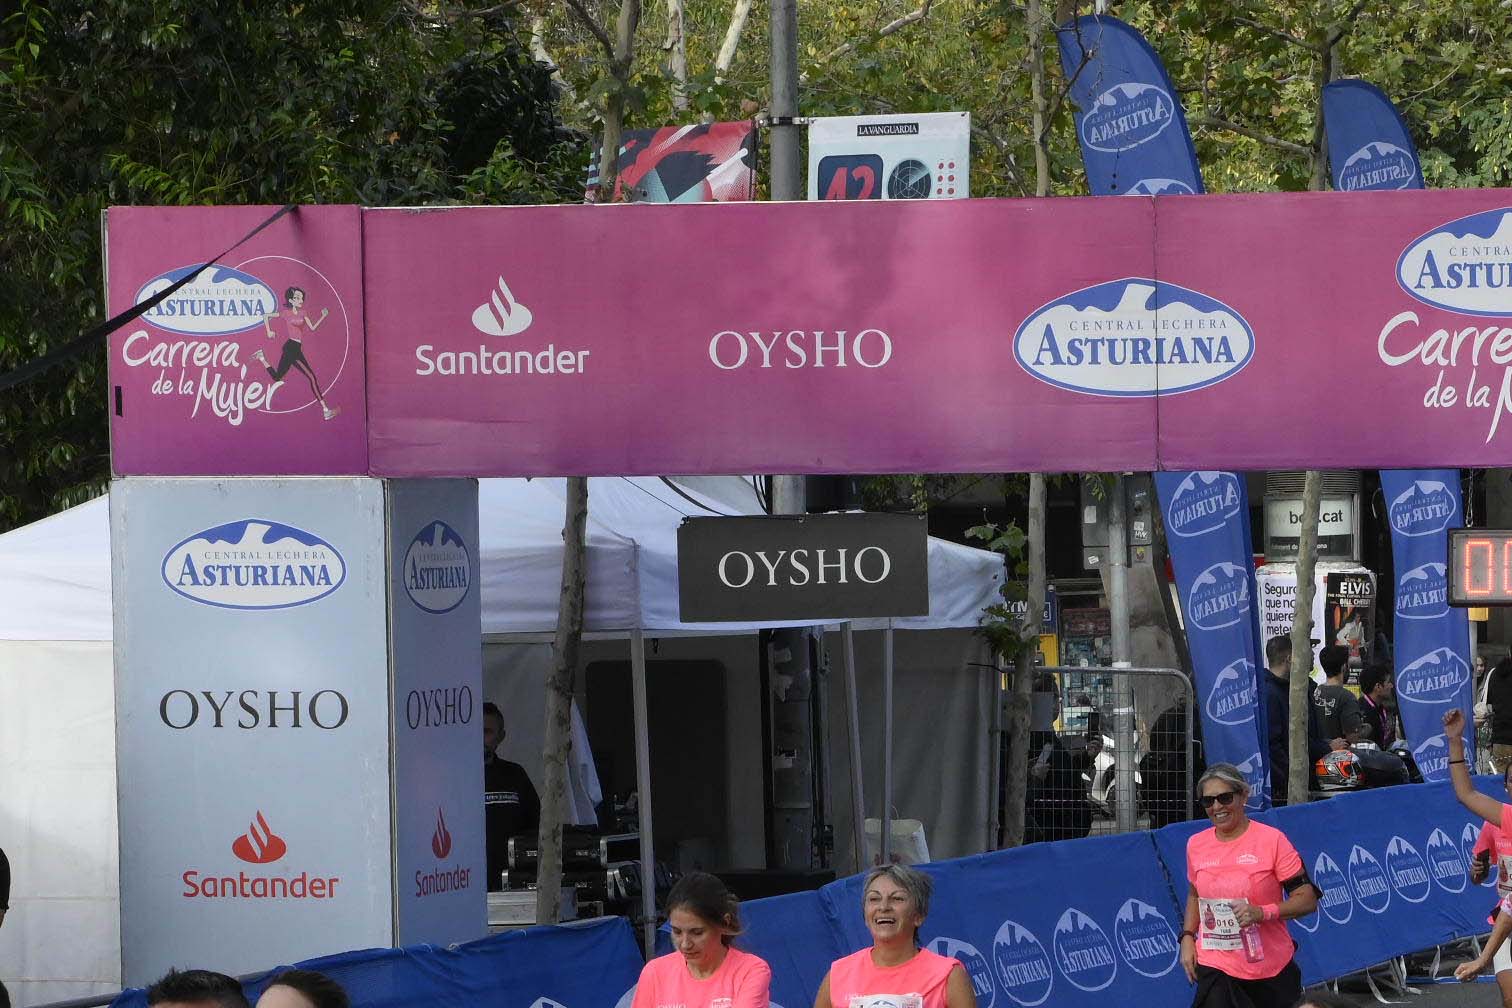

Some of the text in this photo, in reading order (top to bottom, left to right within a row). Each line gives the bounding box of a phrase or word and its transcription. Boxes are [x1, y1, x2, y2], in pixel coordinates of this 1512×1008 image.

[146, 289, 267, 317] ASTURIANA
[1069, 319, 1228, 330] CENTRAL LECHERA
[122, 330, 240, 368] Carrera
[416, 344, 590, 375] Santander
[708, 329, 892, 370] OYSHO
[1032, 324, 1236, 366] ASTURIANA
[151, 368, 194, 395] de la
[191, 365, 286, 426] Mujer
[1423, 368, 1490, 408] de la
[177, 553, 333, 586] ASTURIANA
[204, 551, 326, 560] CENTRAL LECHERA
[718, 546, 891, 587] OYSHO
[409, 558, 467, 591] ASTURIANA
[1340, 582, 1370, 594] ELVIS
[1266, 599, 1281, 610] que
[159, 689, 349, 730] OYSHO
[406, 685, 472, 730] OYSHO
[183, 871, 339, 898] Santander
[415, 865, 470, 897] Santander
[1391, 866, 1429, 888] ASTURIANA
[1217, 919, 1234, 927] 016
[999, 958, 1050, 987] ASTURIANA
[1059, 943, 1113, 973] ASTURIANA
